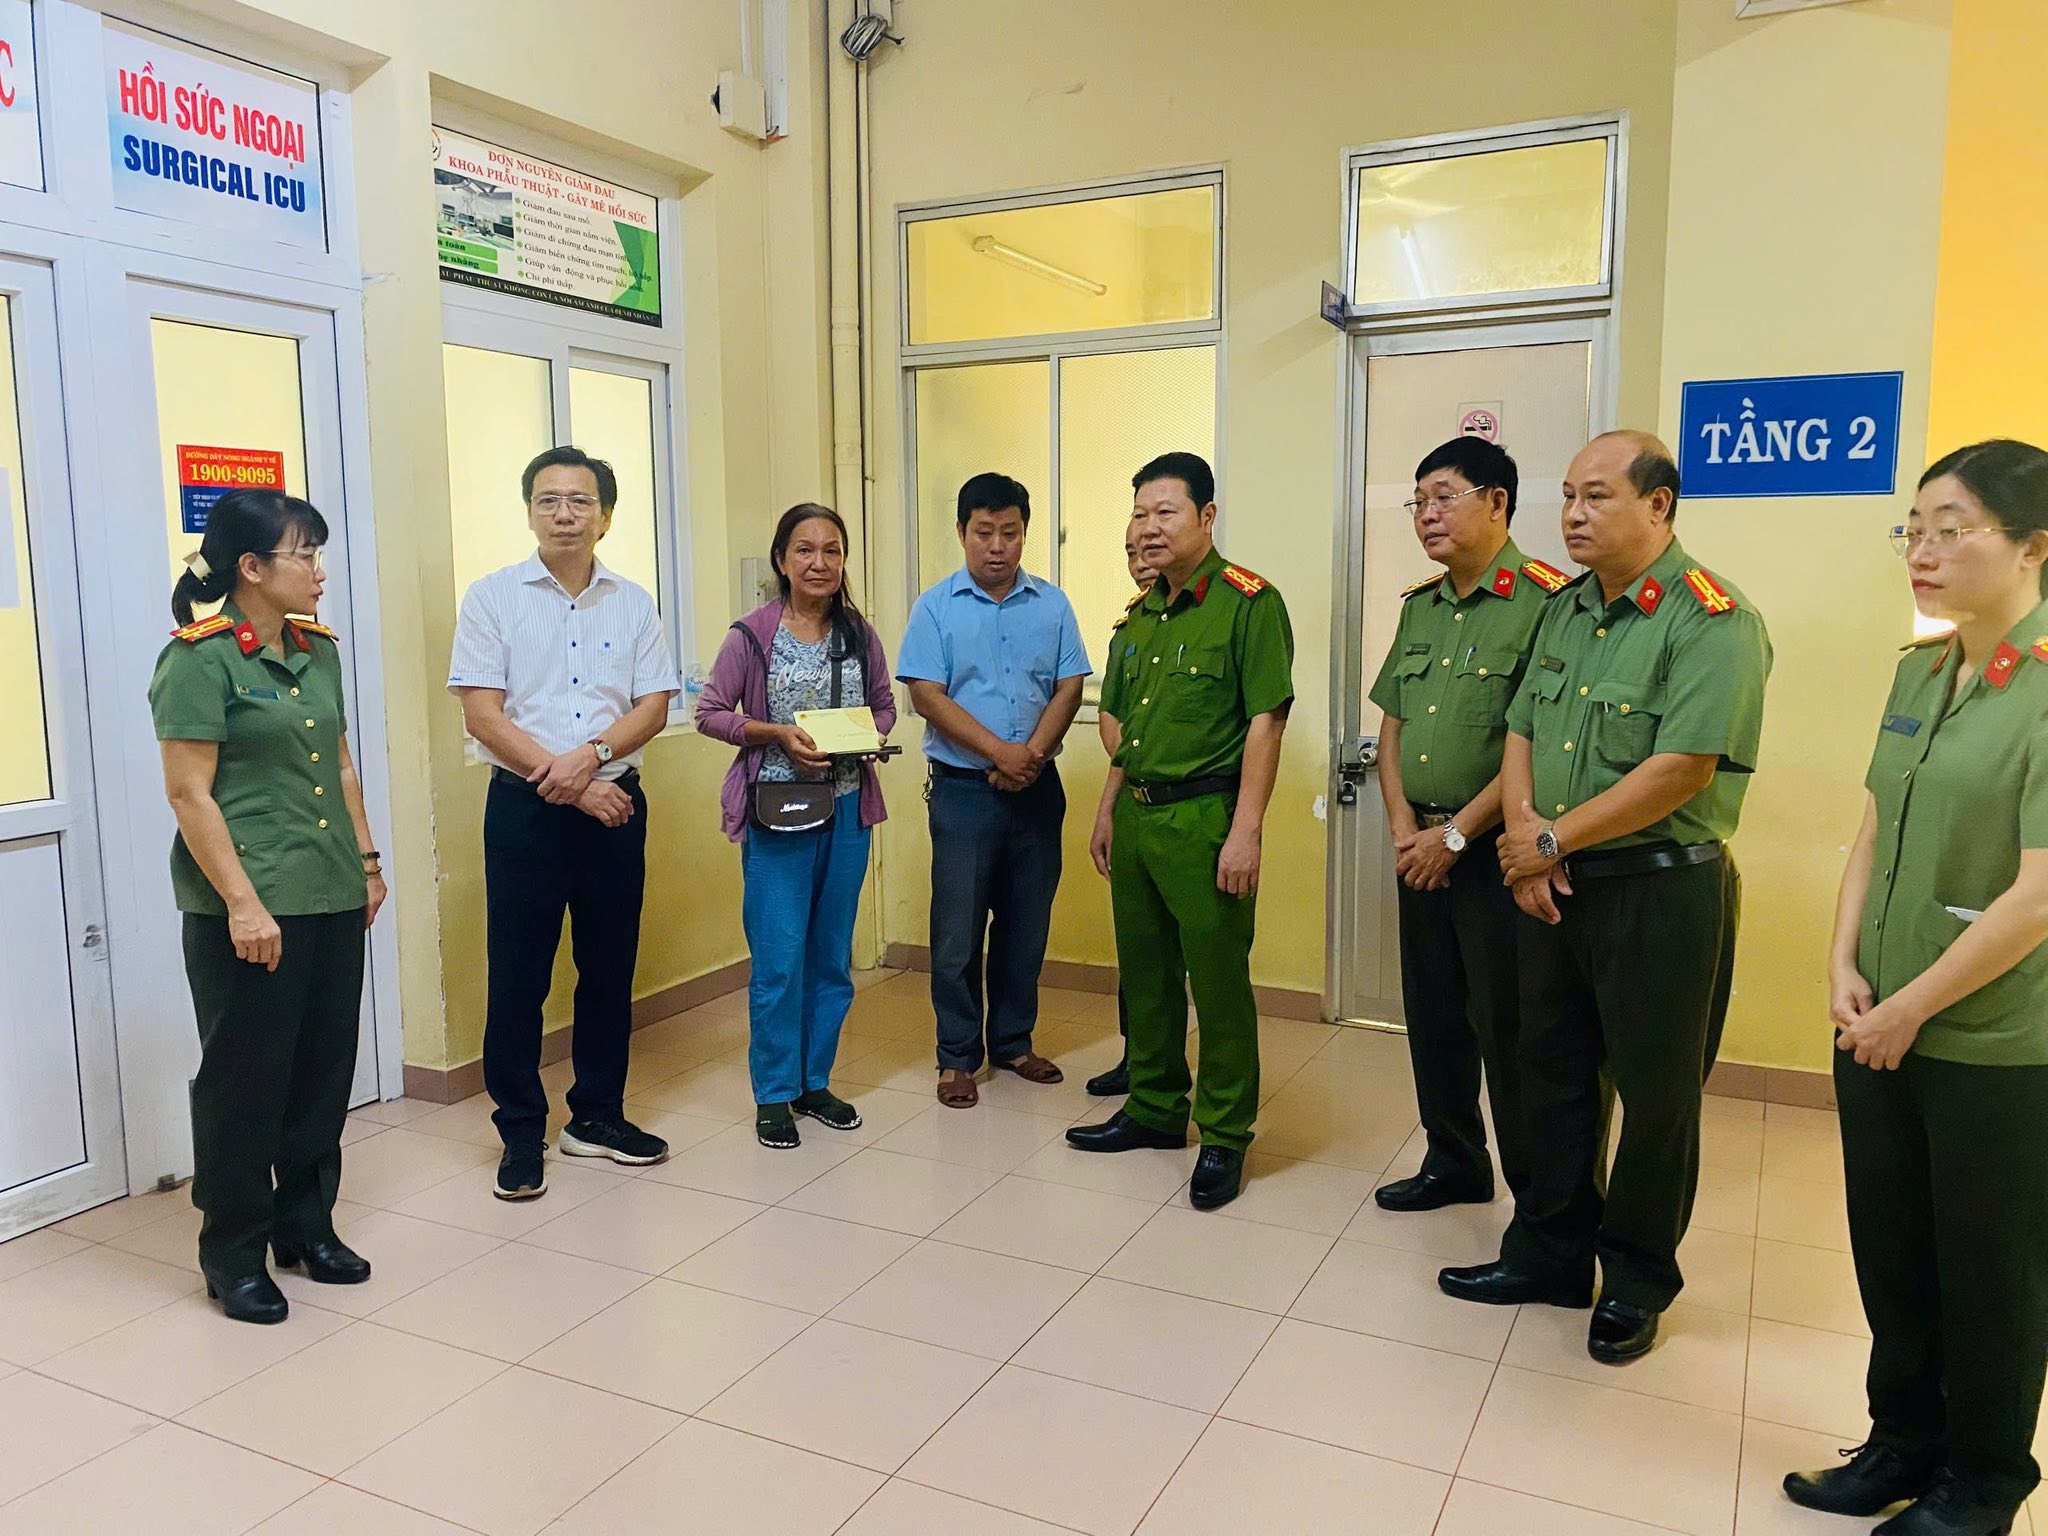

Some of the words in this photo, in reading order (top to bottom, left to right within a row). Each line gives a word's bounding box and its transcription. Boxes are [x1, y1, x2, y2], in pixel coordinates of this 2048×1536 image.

[119, 61, 167, 124] HỒI
[174, 83, 226, 141] SỨC
[233, 104, 305, 170] NGOẠI
[123, 134, 259, 202] SURGICAL
[264, 171, 306, 213] ICU
[448, 156, 484, 176] KHOA
[486, 167, 520, 186] PHẪU
[522, 178, 560, 199] THUẬT
[627, 210, 647, 225] SỨC
[594, 184, 616, 199] ĐAU
[547, 207, 561, 217] đau
[445, 240, 466, 251] toàn
[583, 245, 597, 254] đau
[451, 255, 480, 270] nhàng
[1700, 397, 1832, 464] TẦNG
[1847, 415, 1877, 460] 2
[191, 463, 276, 484] 1900-9095
